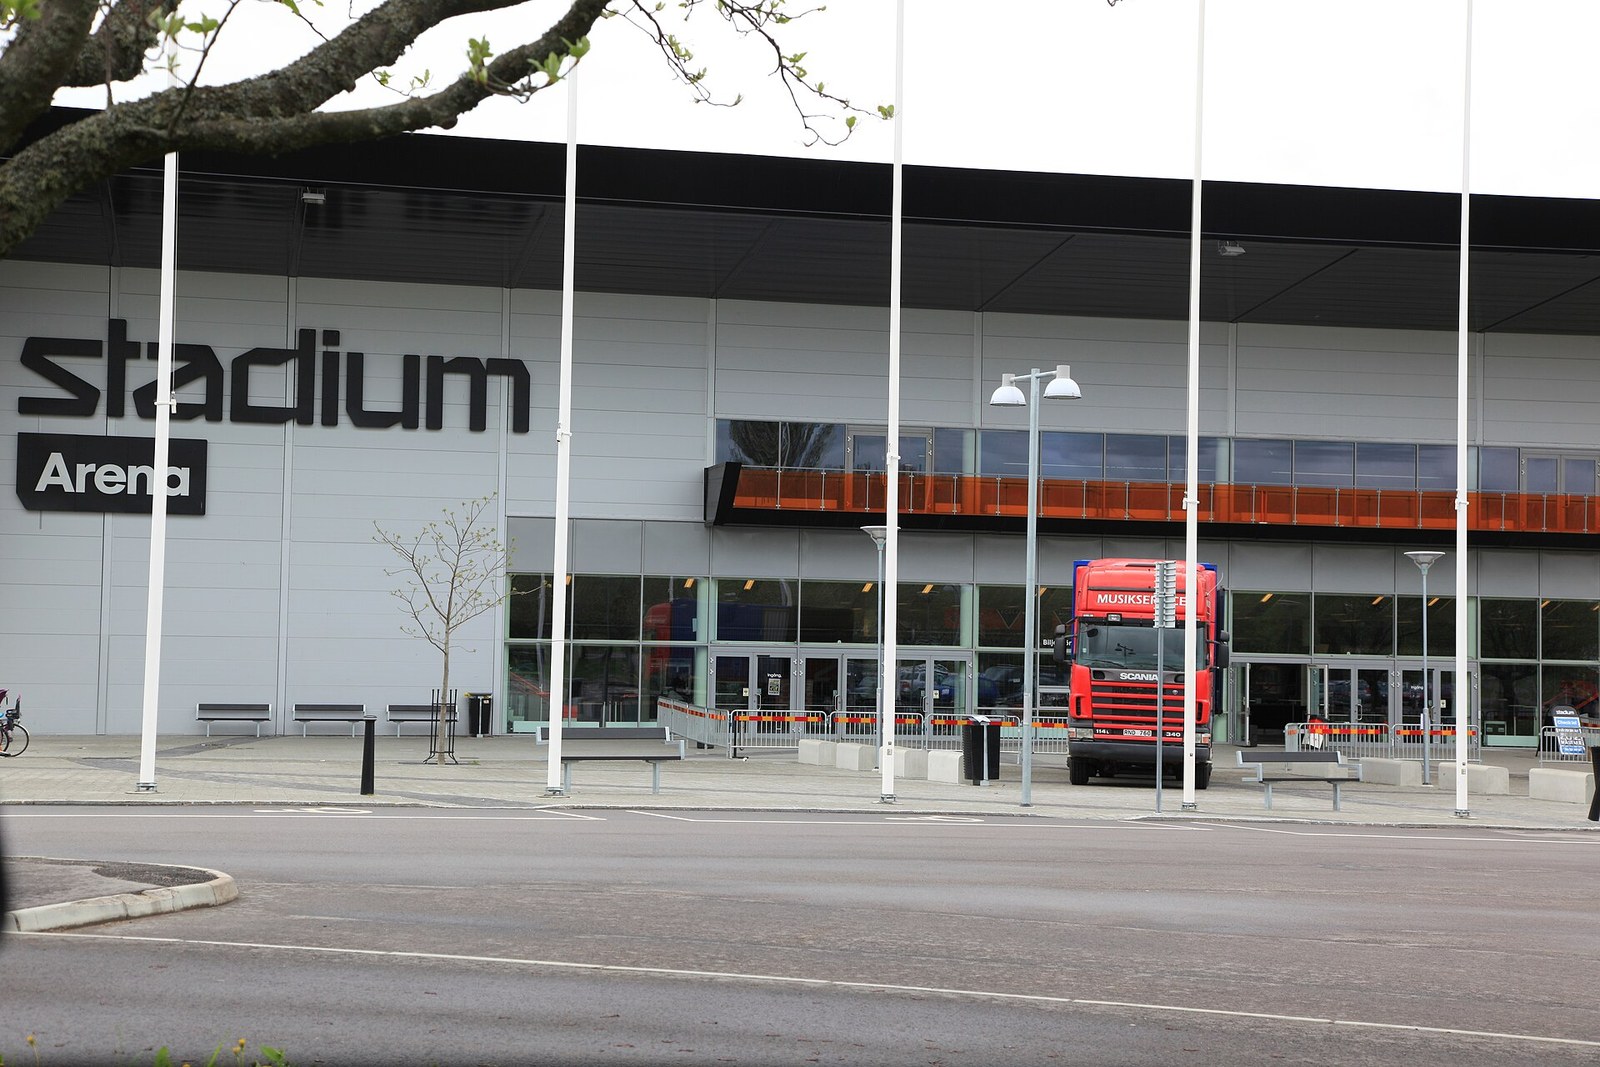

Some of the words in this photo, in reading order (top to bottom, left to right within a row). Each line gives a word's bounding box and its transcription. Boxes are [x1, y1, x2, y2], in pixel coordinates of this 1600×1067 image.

[18, 318, 531, 434] stadium
[35, 452, 190, 497] Arena
[1120, 672, 1159, 681] SCANIA
